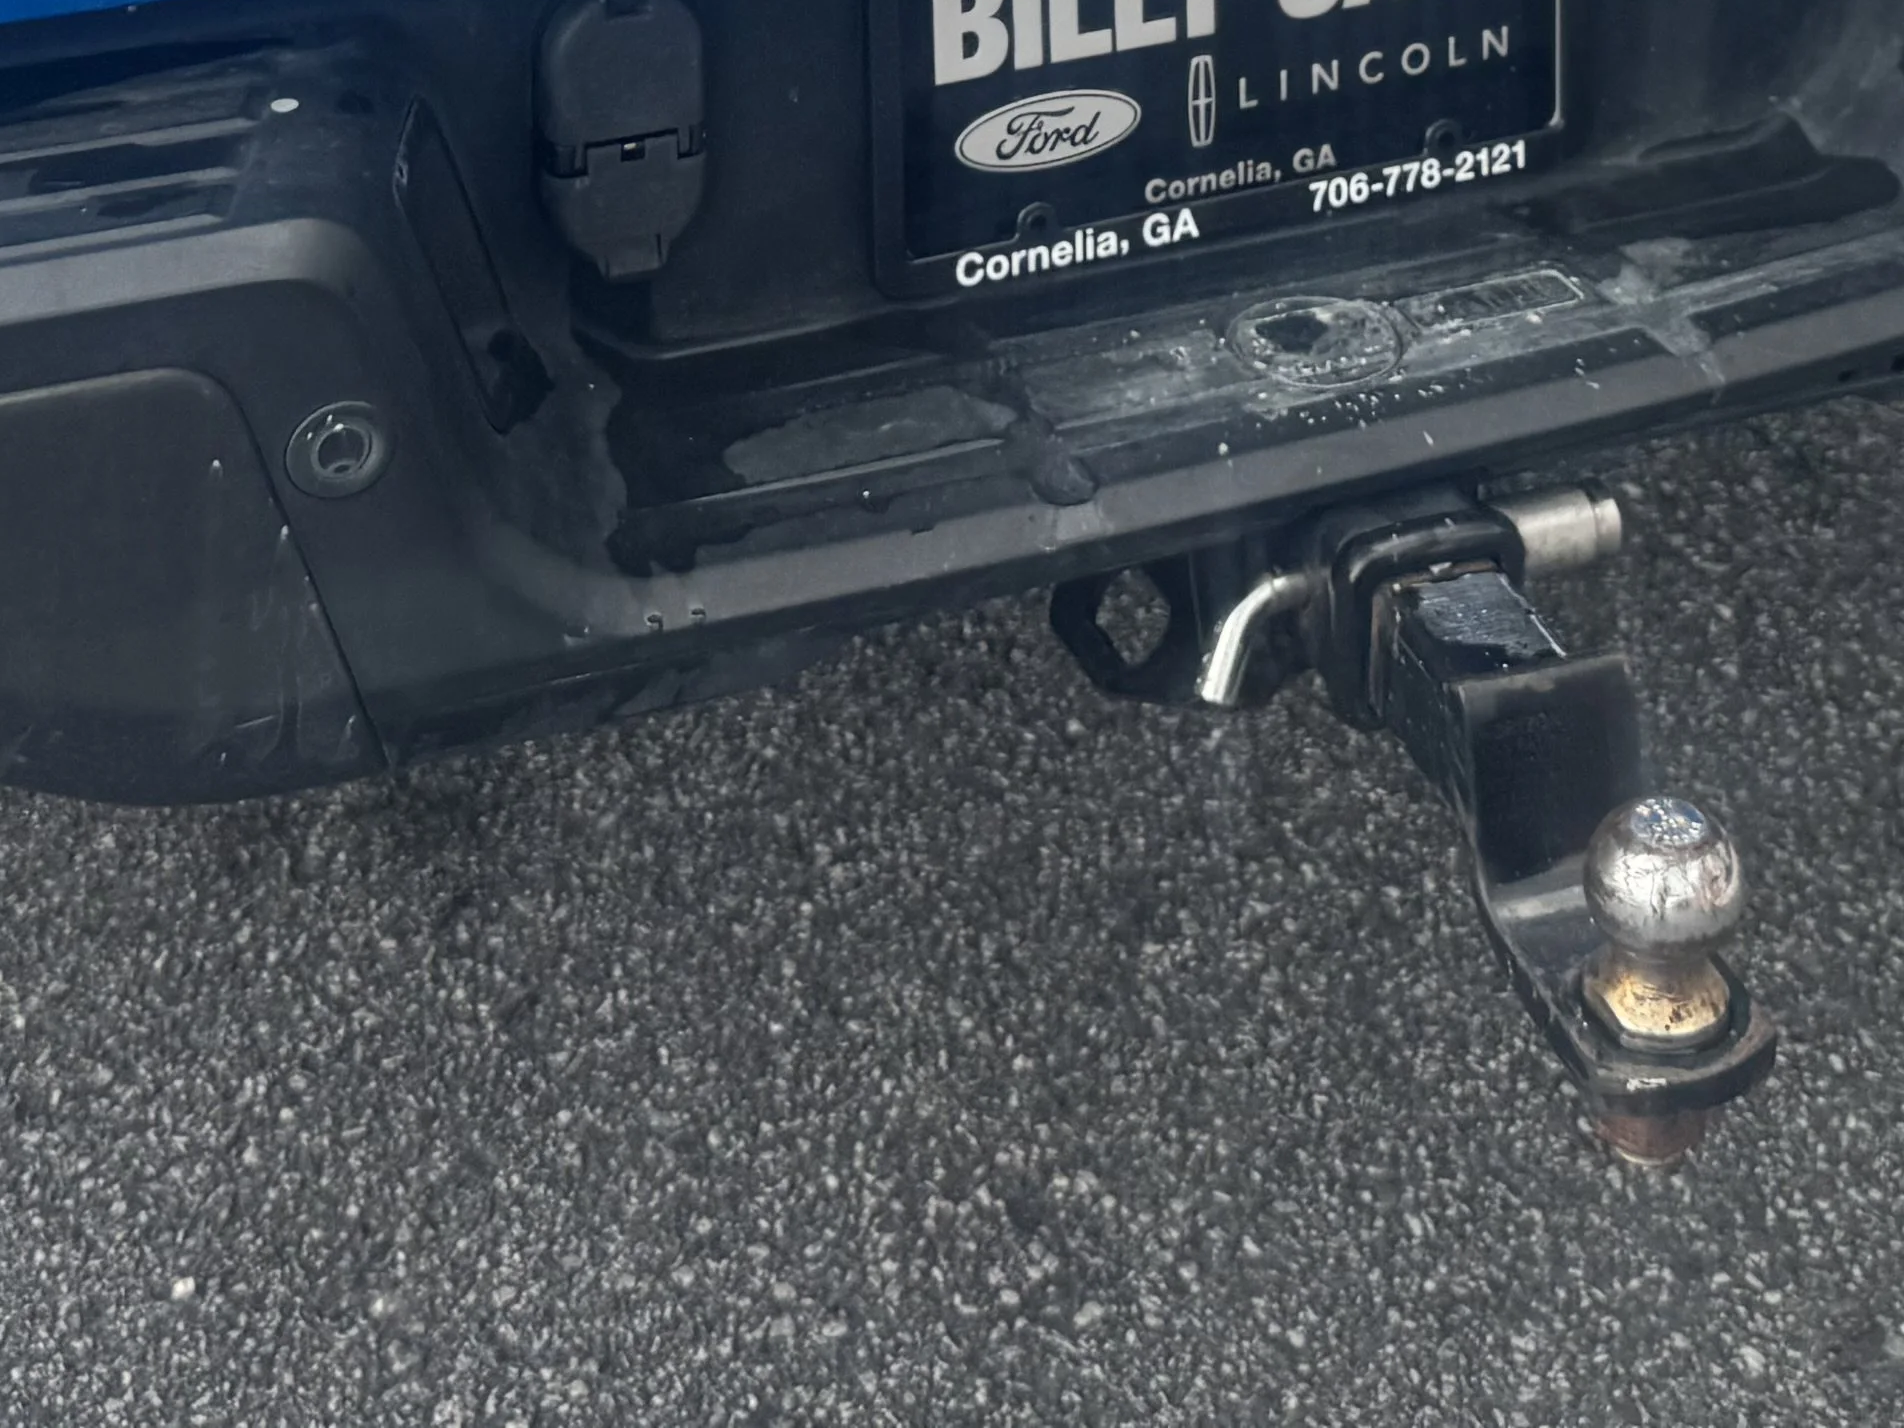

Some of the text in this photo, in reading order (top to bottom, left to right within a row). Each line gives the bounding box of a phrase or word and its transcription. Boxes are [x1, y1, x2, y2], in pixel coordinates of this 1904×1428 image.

[995, 25, 1510, 161] Ford LINCOLN
[955, 142, 1527, 287] Cornelia, GA 706-778-2121
[1144, 143, 1337, 204] Cornelia, GA
